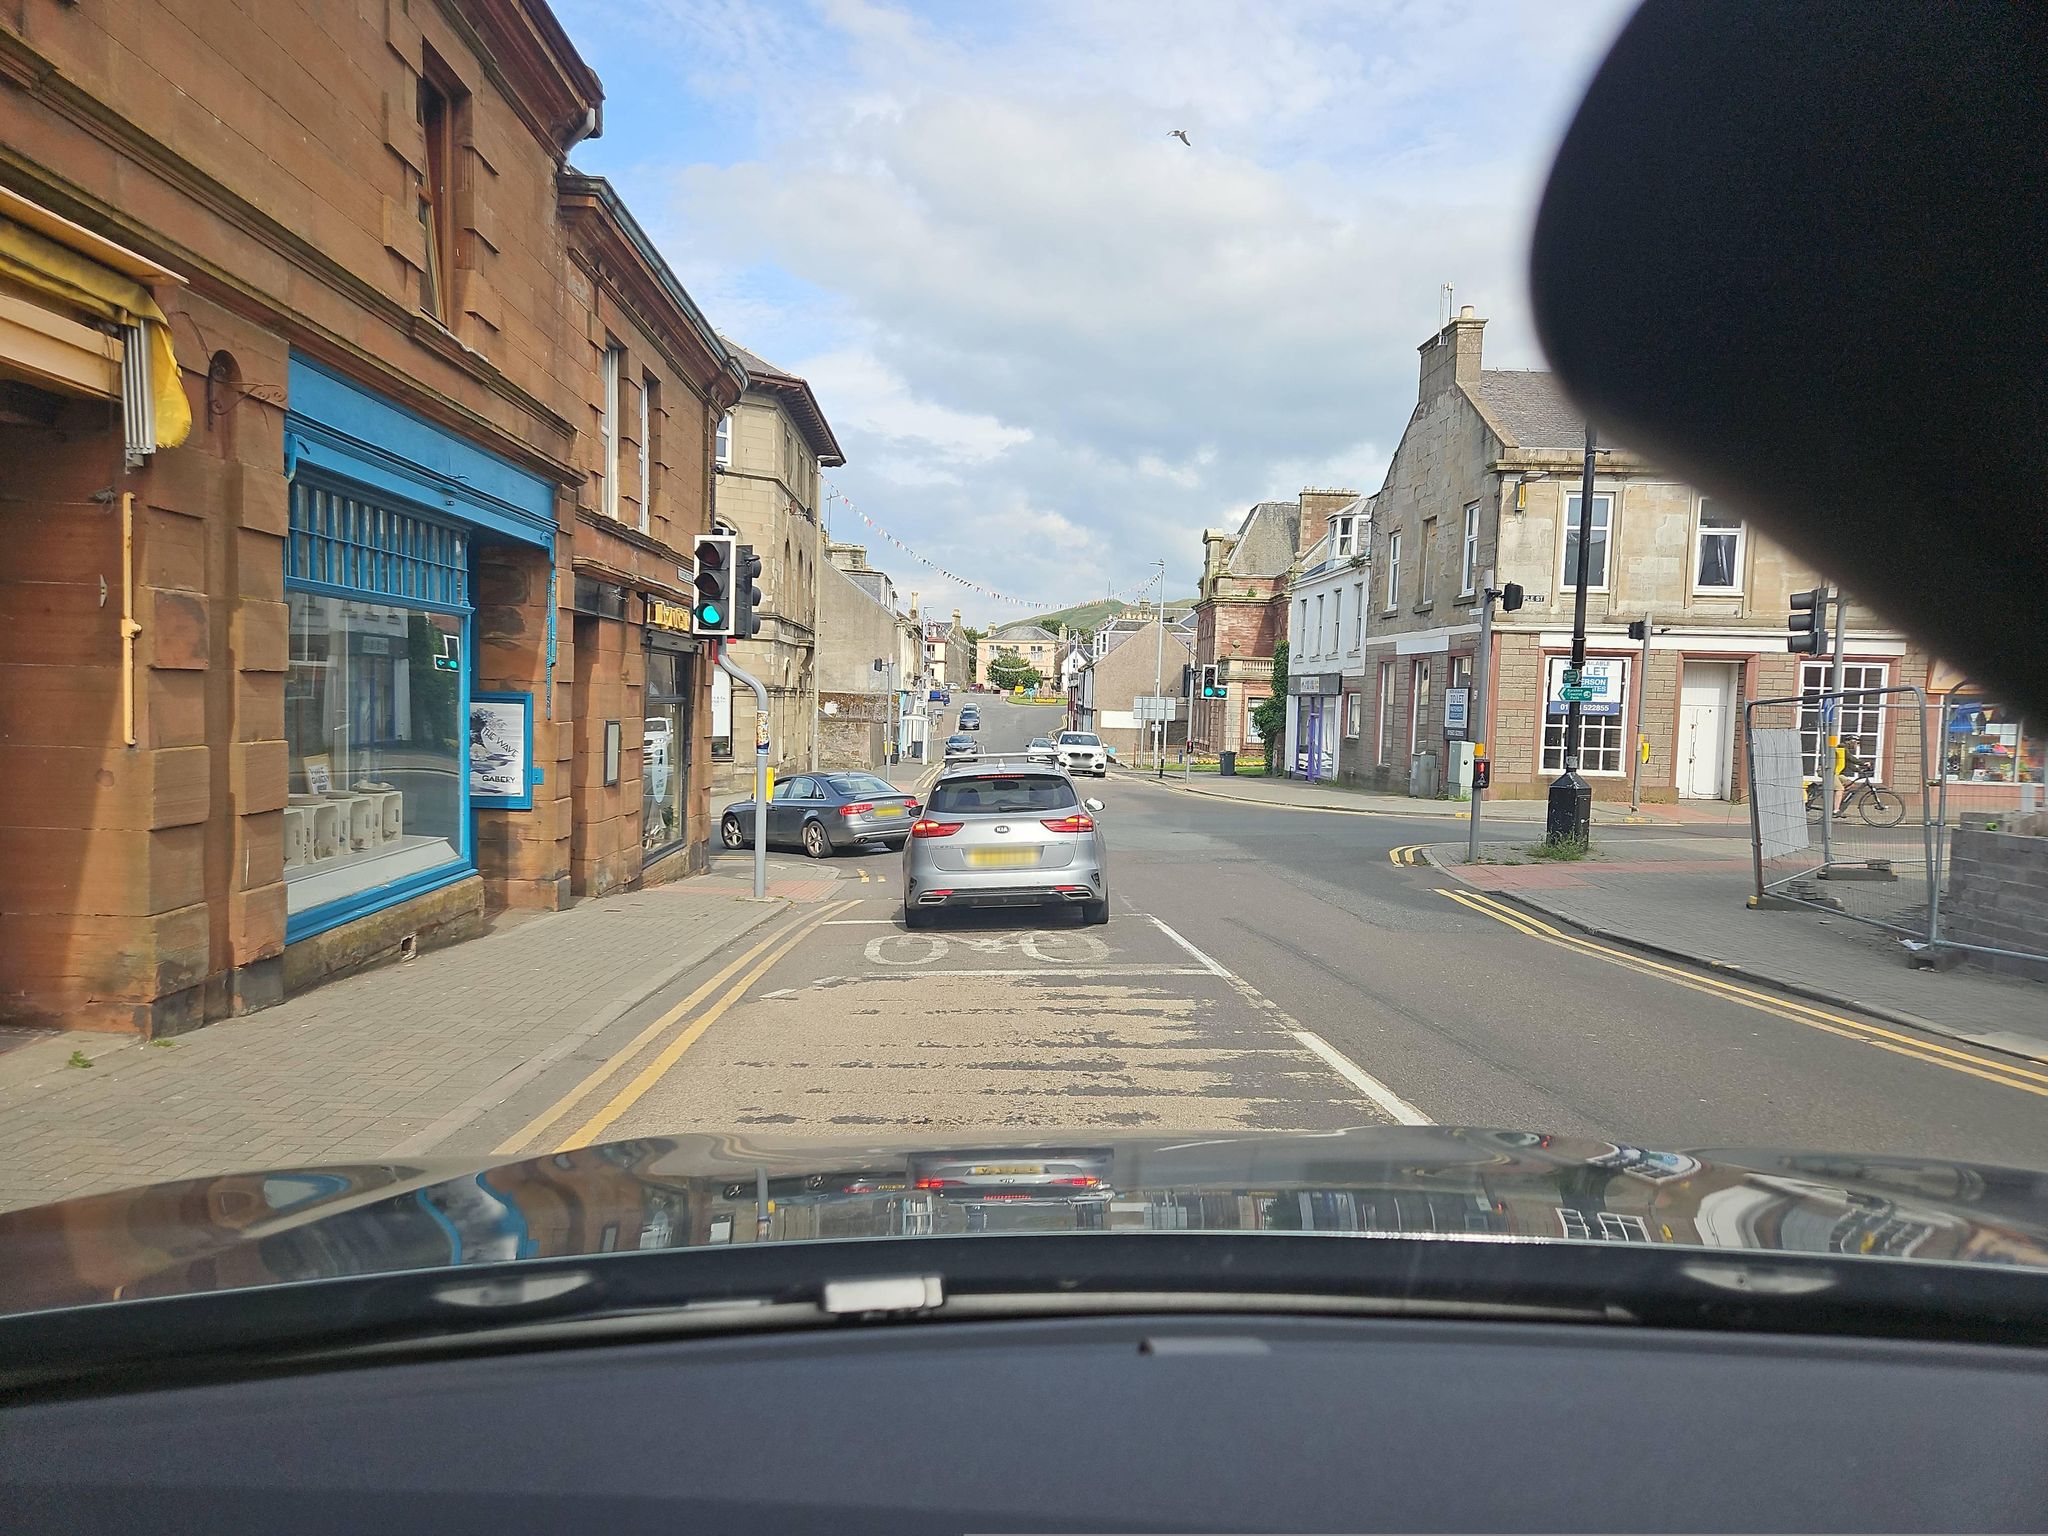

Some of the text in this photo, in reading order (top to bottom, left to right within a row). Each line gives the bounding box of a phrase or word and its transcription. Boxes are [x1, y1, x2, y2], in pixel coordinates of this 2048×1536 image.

[1586, 667, 1608, 676] LET
[1583, 704, 1610, 712] 522855
[482, 728, 520, 758] THE WAVE
